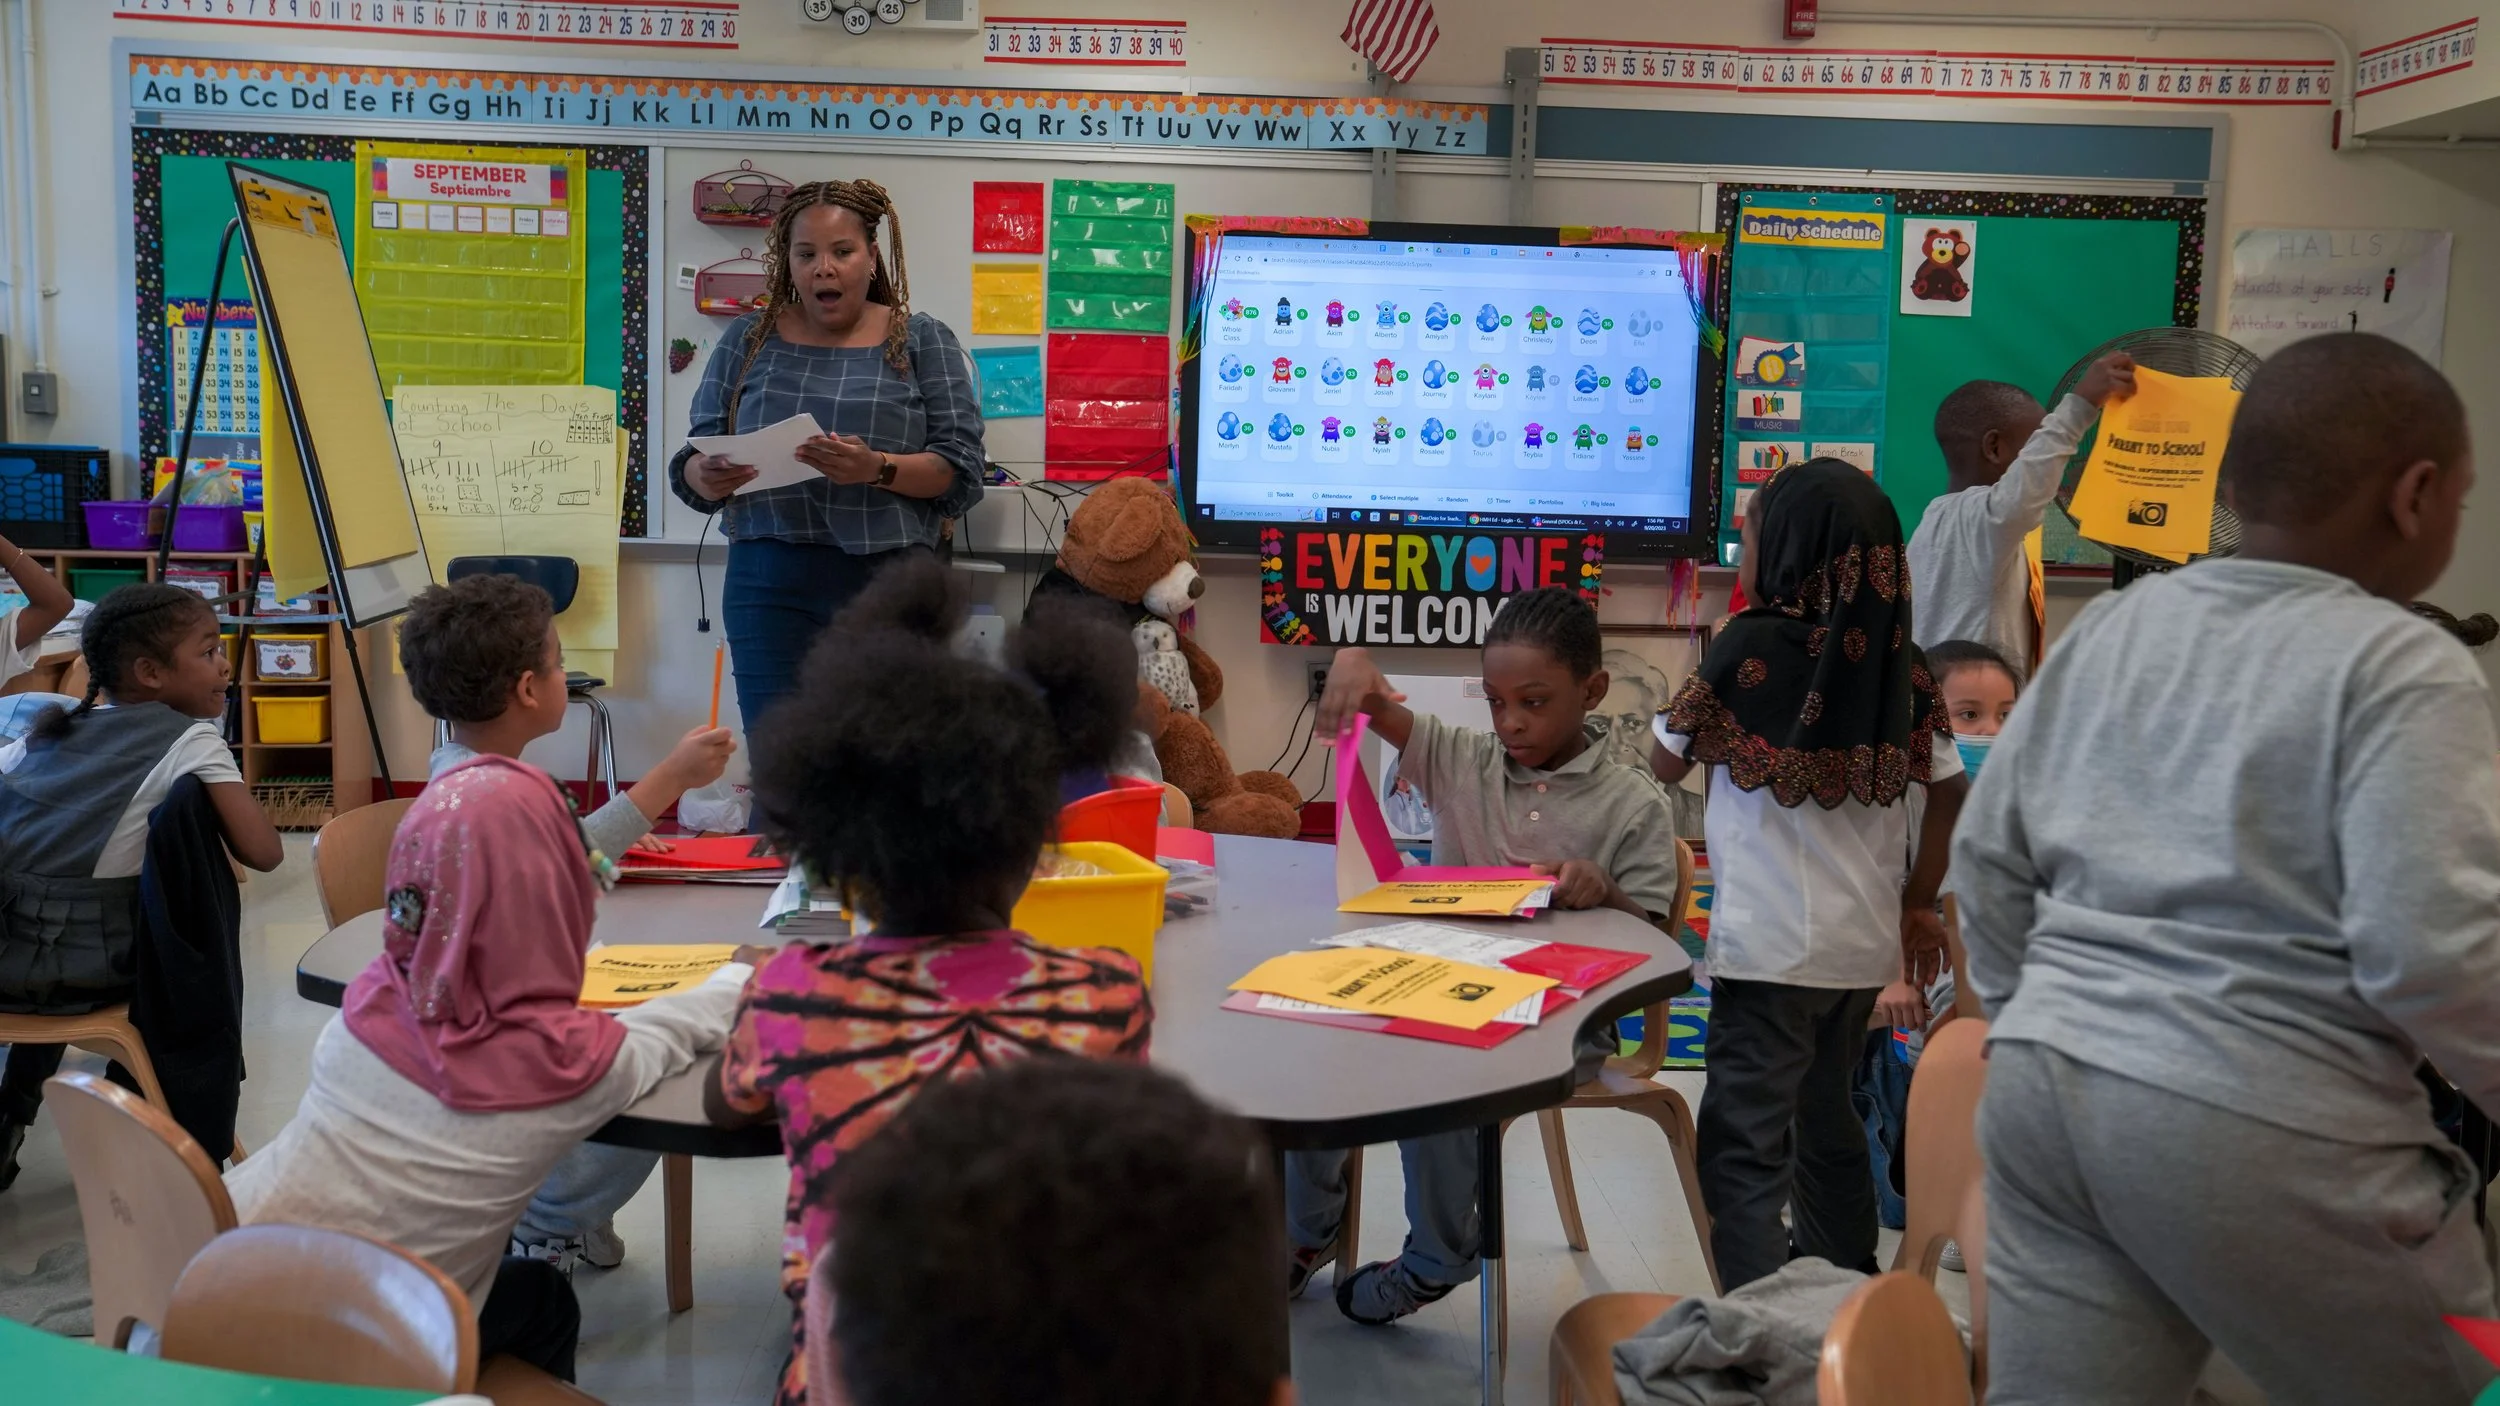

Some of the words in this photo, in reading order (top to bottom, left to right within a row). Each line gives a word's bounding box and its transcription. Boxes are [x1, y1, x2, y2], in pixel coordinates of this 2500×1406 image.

[810, 1, 826, 13] :35
[882, 4, 898, 14] :25
[414, 6, 424, 23] 15
[435, 8, 445, 25] 16
[456, 9, 465, 26] 17
[476, 10, 486, 28] 18
[497, 12, 507, 29] 19
[517, 13, 529, 30] 20
[539, 14, 549, 31] 21
[558, 15, 570, 32] 22
[579, 15, 591, 32] 23
[600, 16, 612, 33] 24
[620, 17, 632, 34] 25
[640, 18, 652, 35] 26
[661, 18, 672, 35] 27
[681, 19, 693, 36] 28
[702, 20, 714, 37] 29
[722, 21, 735, 38] 30
[848, 15, 865, 26] :30
[990, 35, 999, 52] 31
[1008, 35, 1020, 52] 32
[1028, 35, 1040, 52] 33
[1049, 35, 1061, 52] 34
[1069, 36, 1081, 53] 35
[1089, 36, 1101, 54] 36
[1109, 37, 1121, 54] 37
[1129, 37, 1142, 54] 38
[1149, 37, 1161, 55] 39
[1169, 37, 1182, 55] 40
[1544, 55, 1554, 72] 51
[1564, 55, 1575, 72] 52
[1584, 56, 1596, 73] 53
[1603, 57, 1615, 74] 54
[1623, 57, 1635, 74] 55
[1643, 58, 1655, 76] 56
[1663, 59, 1675, 77] 57
[1682, 60, 1695, 77] 58
[1702, 61, 1714, 78] 59
[1722, 62, 1734, 79] 60
[143, 81, 180, 104] Aa
[195, 82, 227, 105] Bb
[240, 85, 277, 108] Cc
[292, 88, 328, 110] Dd
[345, 90, 376, 112] Ee
[392, 91, 414, 112] Ff
[429, 93, 469, 120] Gg
[487, 95, 521, 117] Hh
[545, 97, 564, 119] Ii
[587, 98, 610, 127] Jj
[633, 101, 670, 122] Kk
[692, 102, 712, 124] Ll
[738, 105, 790, 128] Mm
[812, 107, 849, 129] Nn
[870, 108, 912, 131] Oo
[931, 111, 963, 137] Pp
[980, 112, 1021, 139] Qq
[1040, 115, 1065, 135] Rr
[1080, 115, 1107, 136] Ss
[1122, 116, 1144, 136] Tt
[1158, 117, 1190, 138] Uu
[1206, 119, 1240, 139] Vv
[1255, 120, 1301, 141] Ww
[1330, 121, 1365, 141] Xx
[1388, 121, 1419, 147] Yy
[1436, 126, 1466, 147] Zz
[414, 164, 526, 183] SEPTEMBER
[431, 183, 511, 197] Septiembre
[1749, 221, 1798, 240] Daily
[1800, 222, 1882, 241] Schedule
[2278, 234, 2384, 259] HALLS
[236, 333, 240, 341] 5
[220, 348, 228, 356] 14
[248, 348, 256, 357] 16
[400, 393, 469, 415] Counting
[482, 393, 515, 413] The
[542, 394, 590, 420] Days
[398, 414, 414, 432] of
[437, 414, 501, 432] School
[433, 439, 442, 457] 9
[532, 440, 553, 455] 10
[2146, 443, 2160, 454] TO
[1296, 534, 1567, 592] EVERYONE
[1306, 593, 1319, 613] IS
[1325, 594, 1509, 644] WELCOM
[683, 958, 733, 967] SCHO
